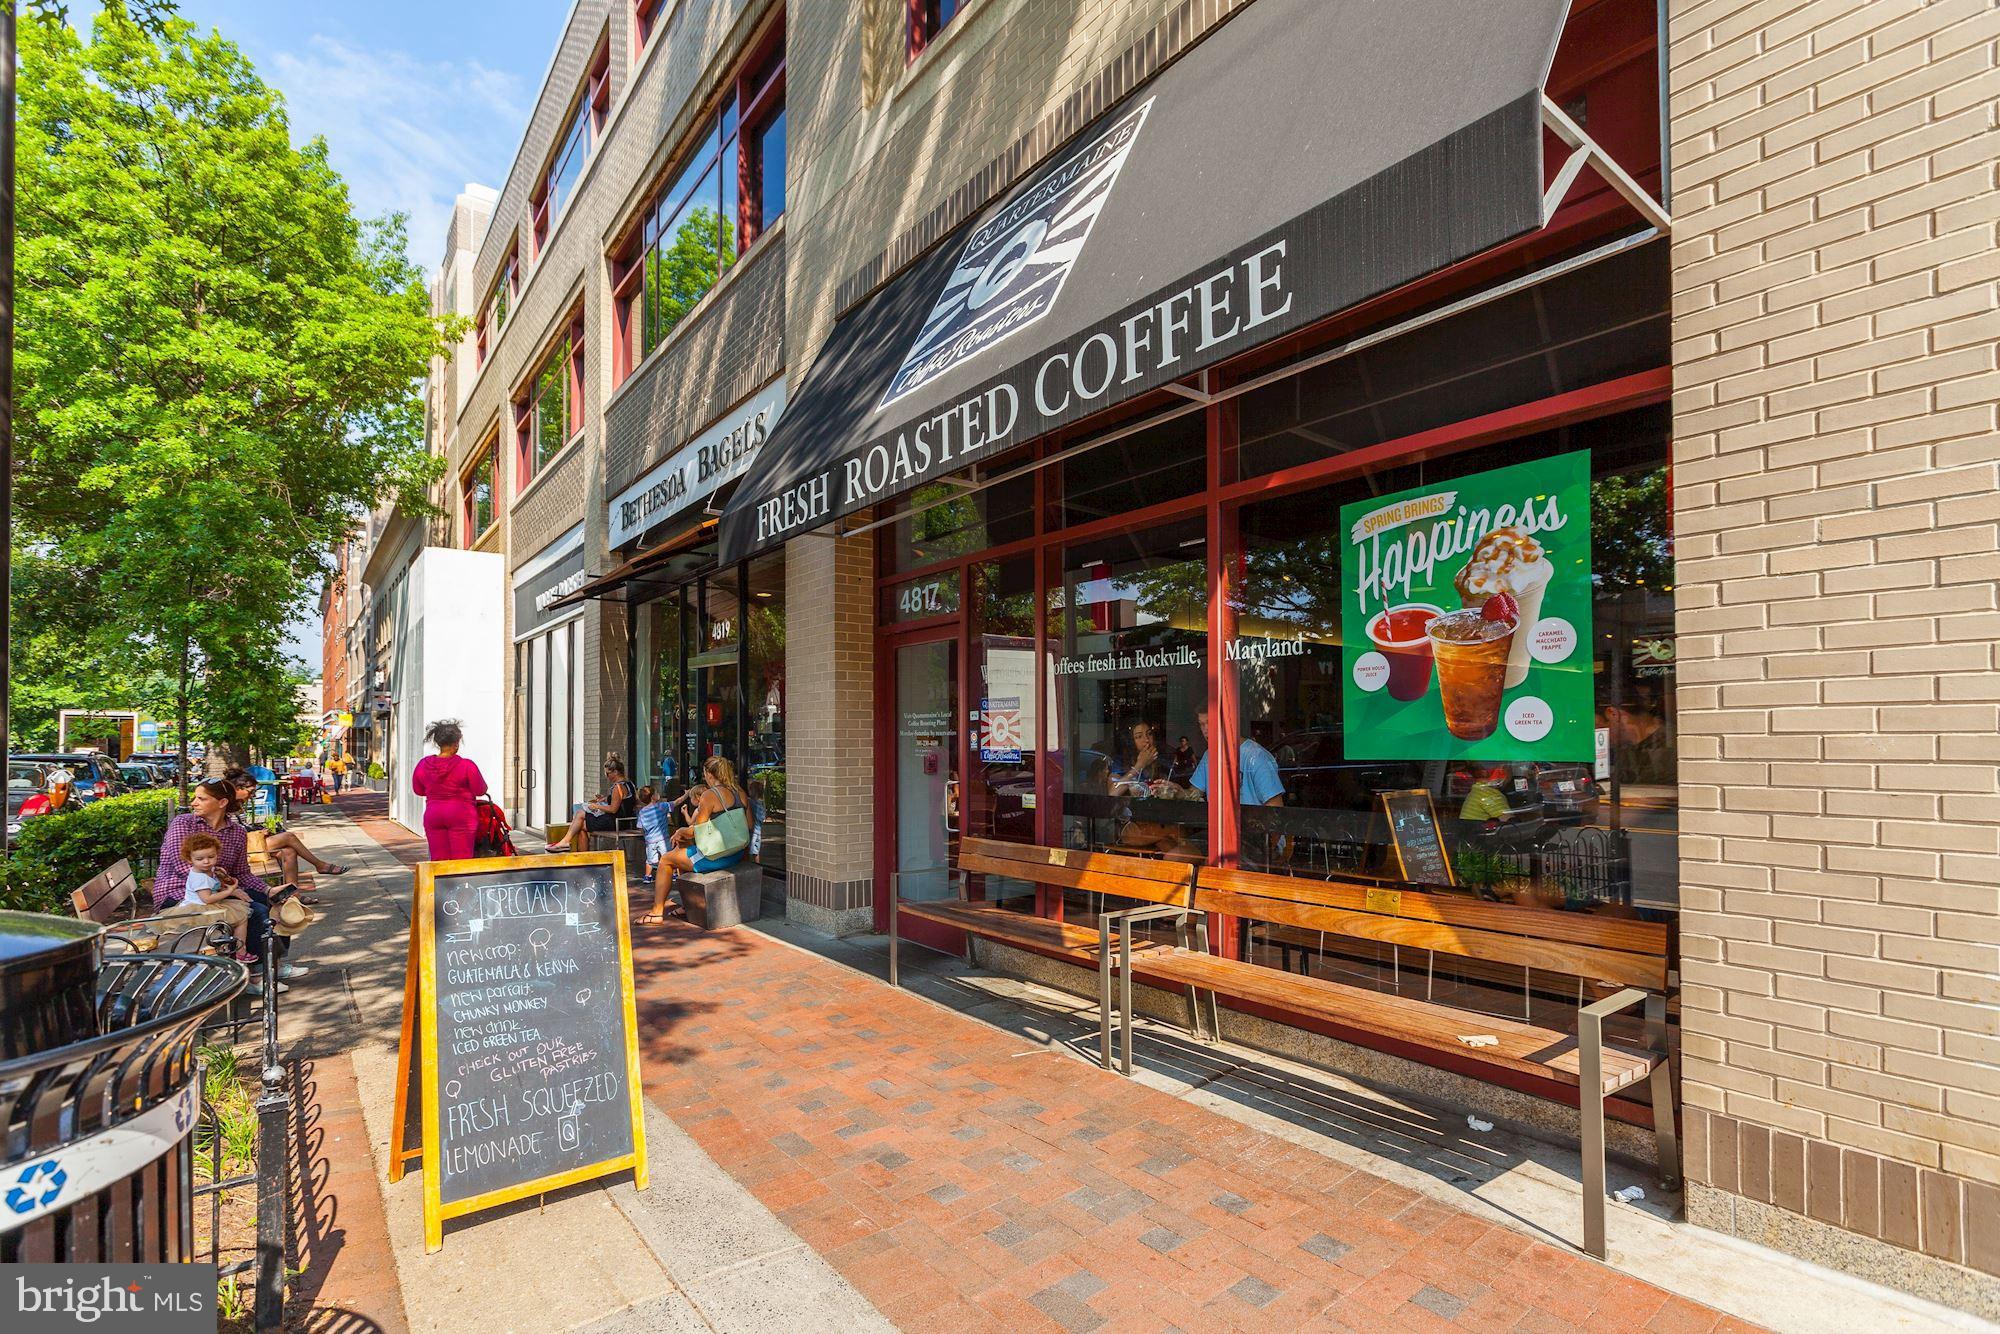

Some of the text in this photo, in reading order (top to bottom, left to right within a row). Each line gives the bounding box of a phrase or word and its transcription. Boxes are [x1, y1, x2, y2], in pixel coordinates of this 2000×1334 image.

[971, 121, 1135, 251] QUARTERMAINE
[756, 239, 1293, 542] FRESH ROASTED COFFEE
[696, 412, 767, 484] BAGELS
[1363, 496, 1446, 535] SPRING BRINGS
[1358, 495, 1569, 616] Happiness
[900, 582, 940, 614] 4817
[711, 620, 731, 641] 4819
[1535, 635, 1568, 645] MACCHIATO
[1537, 629, 1564, 639] CARAMEL
[1053, 656, 1085, 676] offees
[1087, 653, 1117, 672] fresh
[1119, 651, 1131, 670] in
[1135, 644, 1202, 669] Rockville,
[1541, 643, 1563, 651] FRAPPE
[447, 943, 520, 967] new crop:
[447, 964, 521, 985] GUATEMALA
[537, 958, 580, 978] KENYA
[450, 982, 534, 1008] new parfait:
[453, 997, 548, 1024] CHUNKY MONKEY
[452, 1028, 541, 1056] ICED GREEN TEA
[453, 1019, 527, 1040] new drink:
[458, 1036, 565, 1077] CHECK OUT OUR
[490, 1042, 584, 1082] GLUTEN FREE
[540, 1049, 598, 1078] PASTRIES
[448, 1071, 619, 1141] FRESH SQUEEZED
[446, 1131, 545, 1176] LEMONADE
